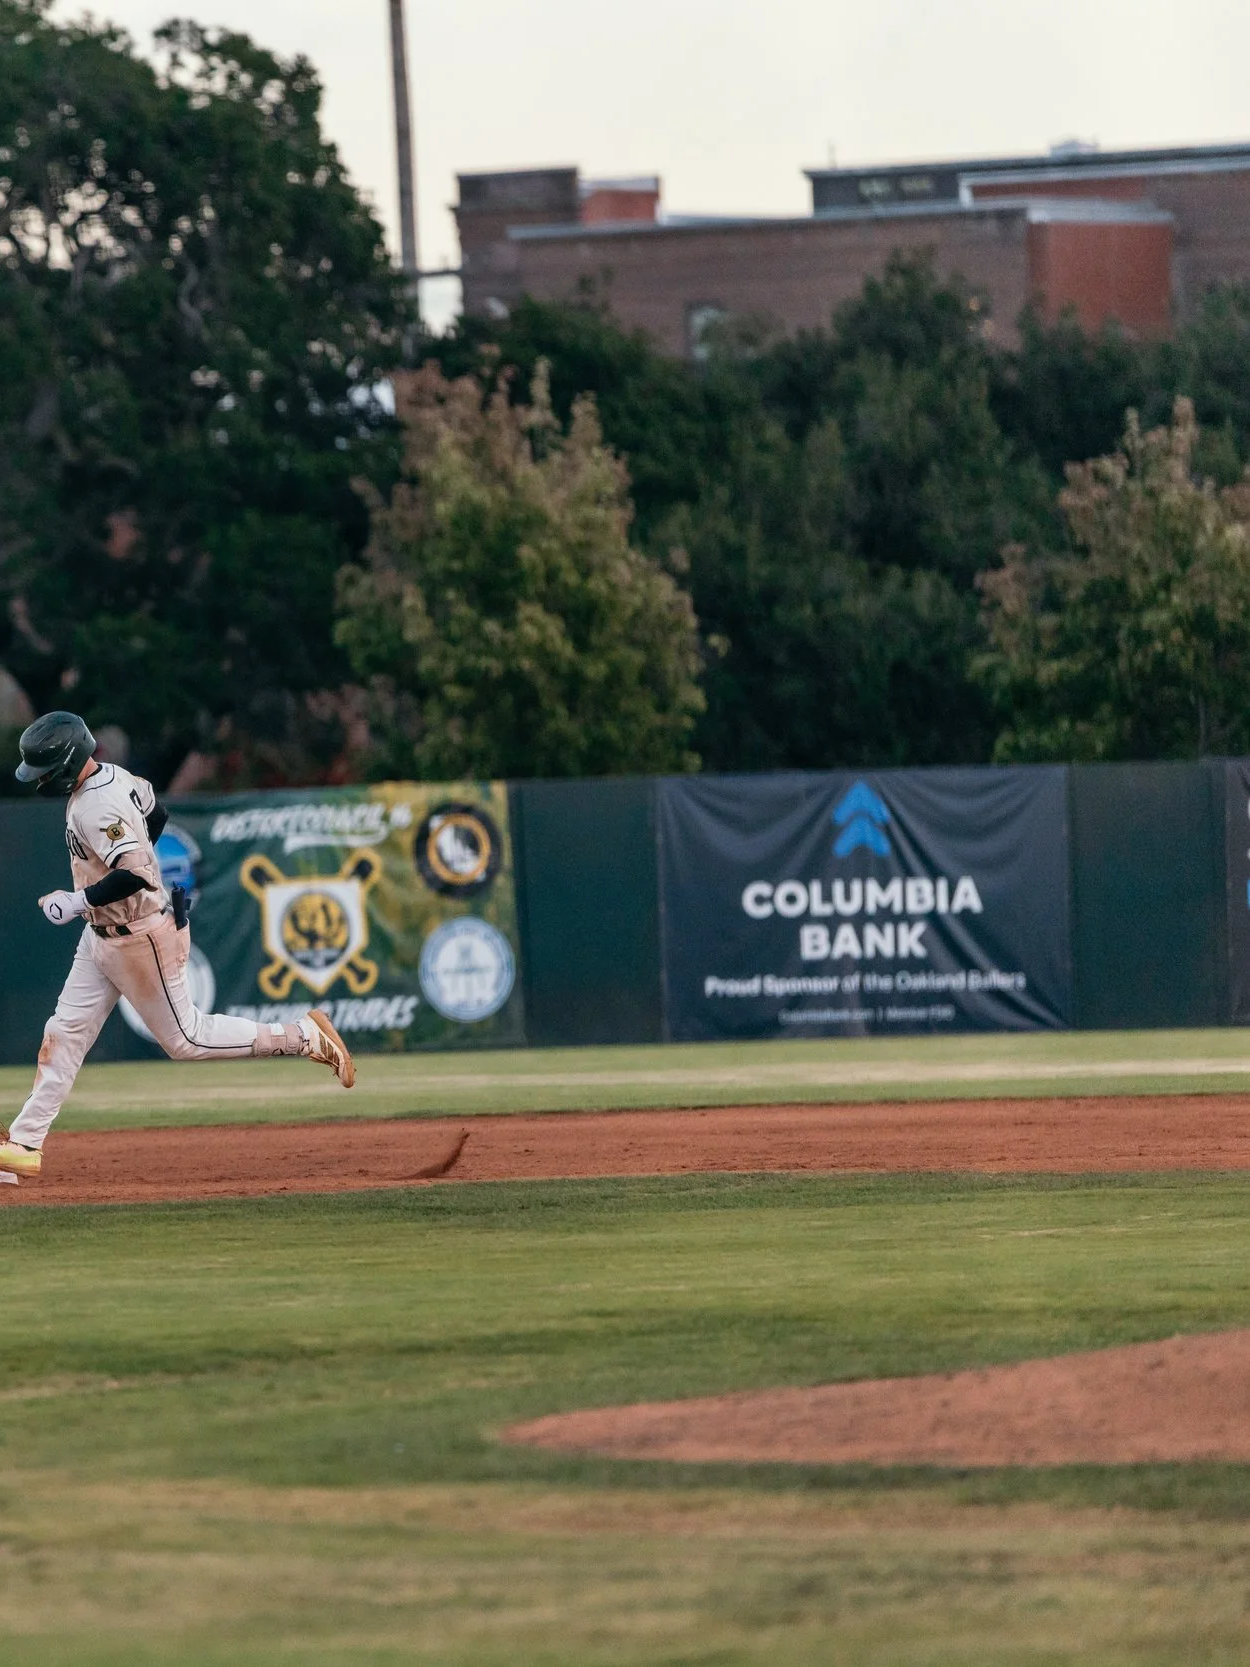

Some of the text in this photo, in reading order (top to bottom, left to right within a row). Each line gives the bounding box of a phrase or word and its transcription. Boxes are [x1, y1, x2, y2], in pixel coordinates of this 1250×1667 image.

[742, 875, 983, 919] COLUMBIA
[800, 920, 929, 961] BANK
[705, 967, 1027, 998] Proud Sponsor of the Oakland Ballers
